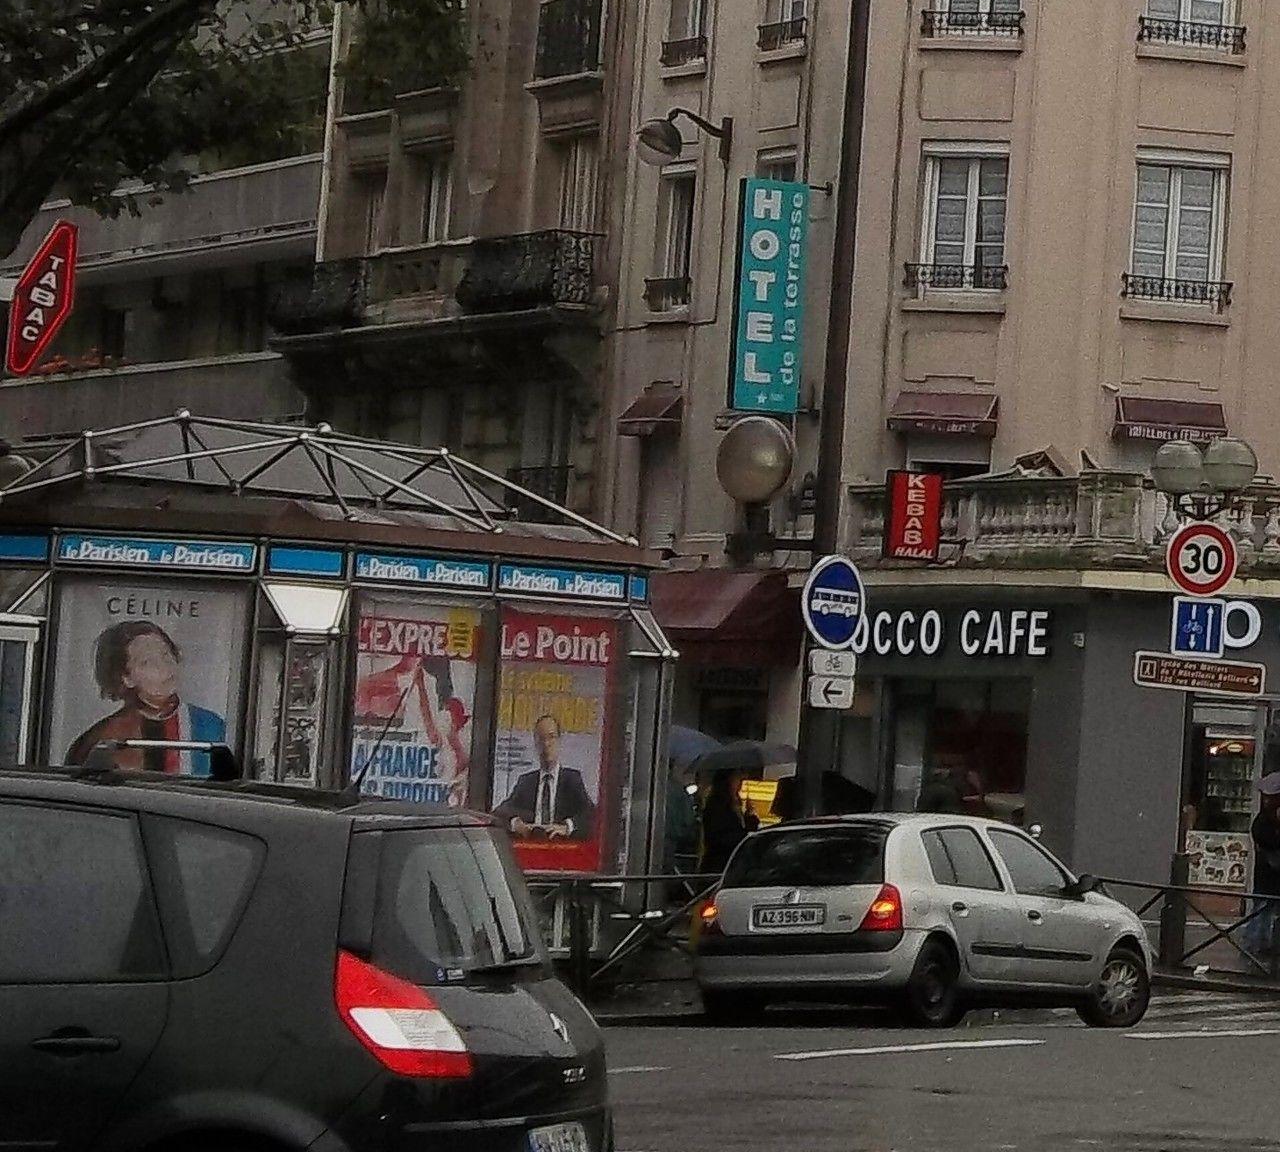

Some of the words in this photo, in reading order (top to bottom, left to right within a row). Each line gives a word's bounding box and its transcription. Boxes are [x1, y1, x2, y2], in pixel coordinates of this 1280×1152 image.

[784, 193, 804, 308] terrasse
[22, 255, 65, 342] TABAC
[744, 188, 783, 384] HOTEL
[781, 318, 796, 342] la
[780, 351, 795, 385] de
[903, 474, 926, 545] KEBAB
[79, 541, 149, 563] Parisien
[173, 546, 244, 567] Parisien
[894, 546, 934, 559] HALAL
[1182, 543, 1223, 575] 30
[369, 558, 419, 581] Parisien
[435, 562, 484, 587] Parisien
[512, 569, 559, 592] Parisien
[575, 575, 620, 598] Parisien
[106, 594, 200, 617] CÉLINE
[358, 617, 473, 658] L'EXPRE
[501, 624, 531, 659] Le
[535, 625, 610, 664] Point
[850, 609, 941, 654] OCCO
[961, 609, 1048, 655] CAFE
